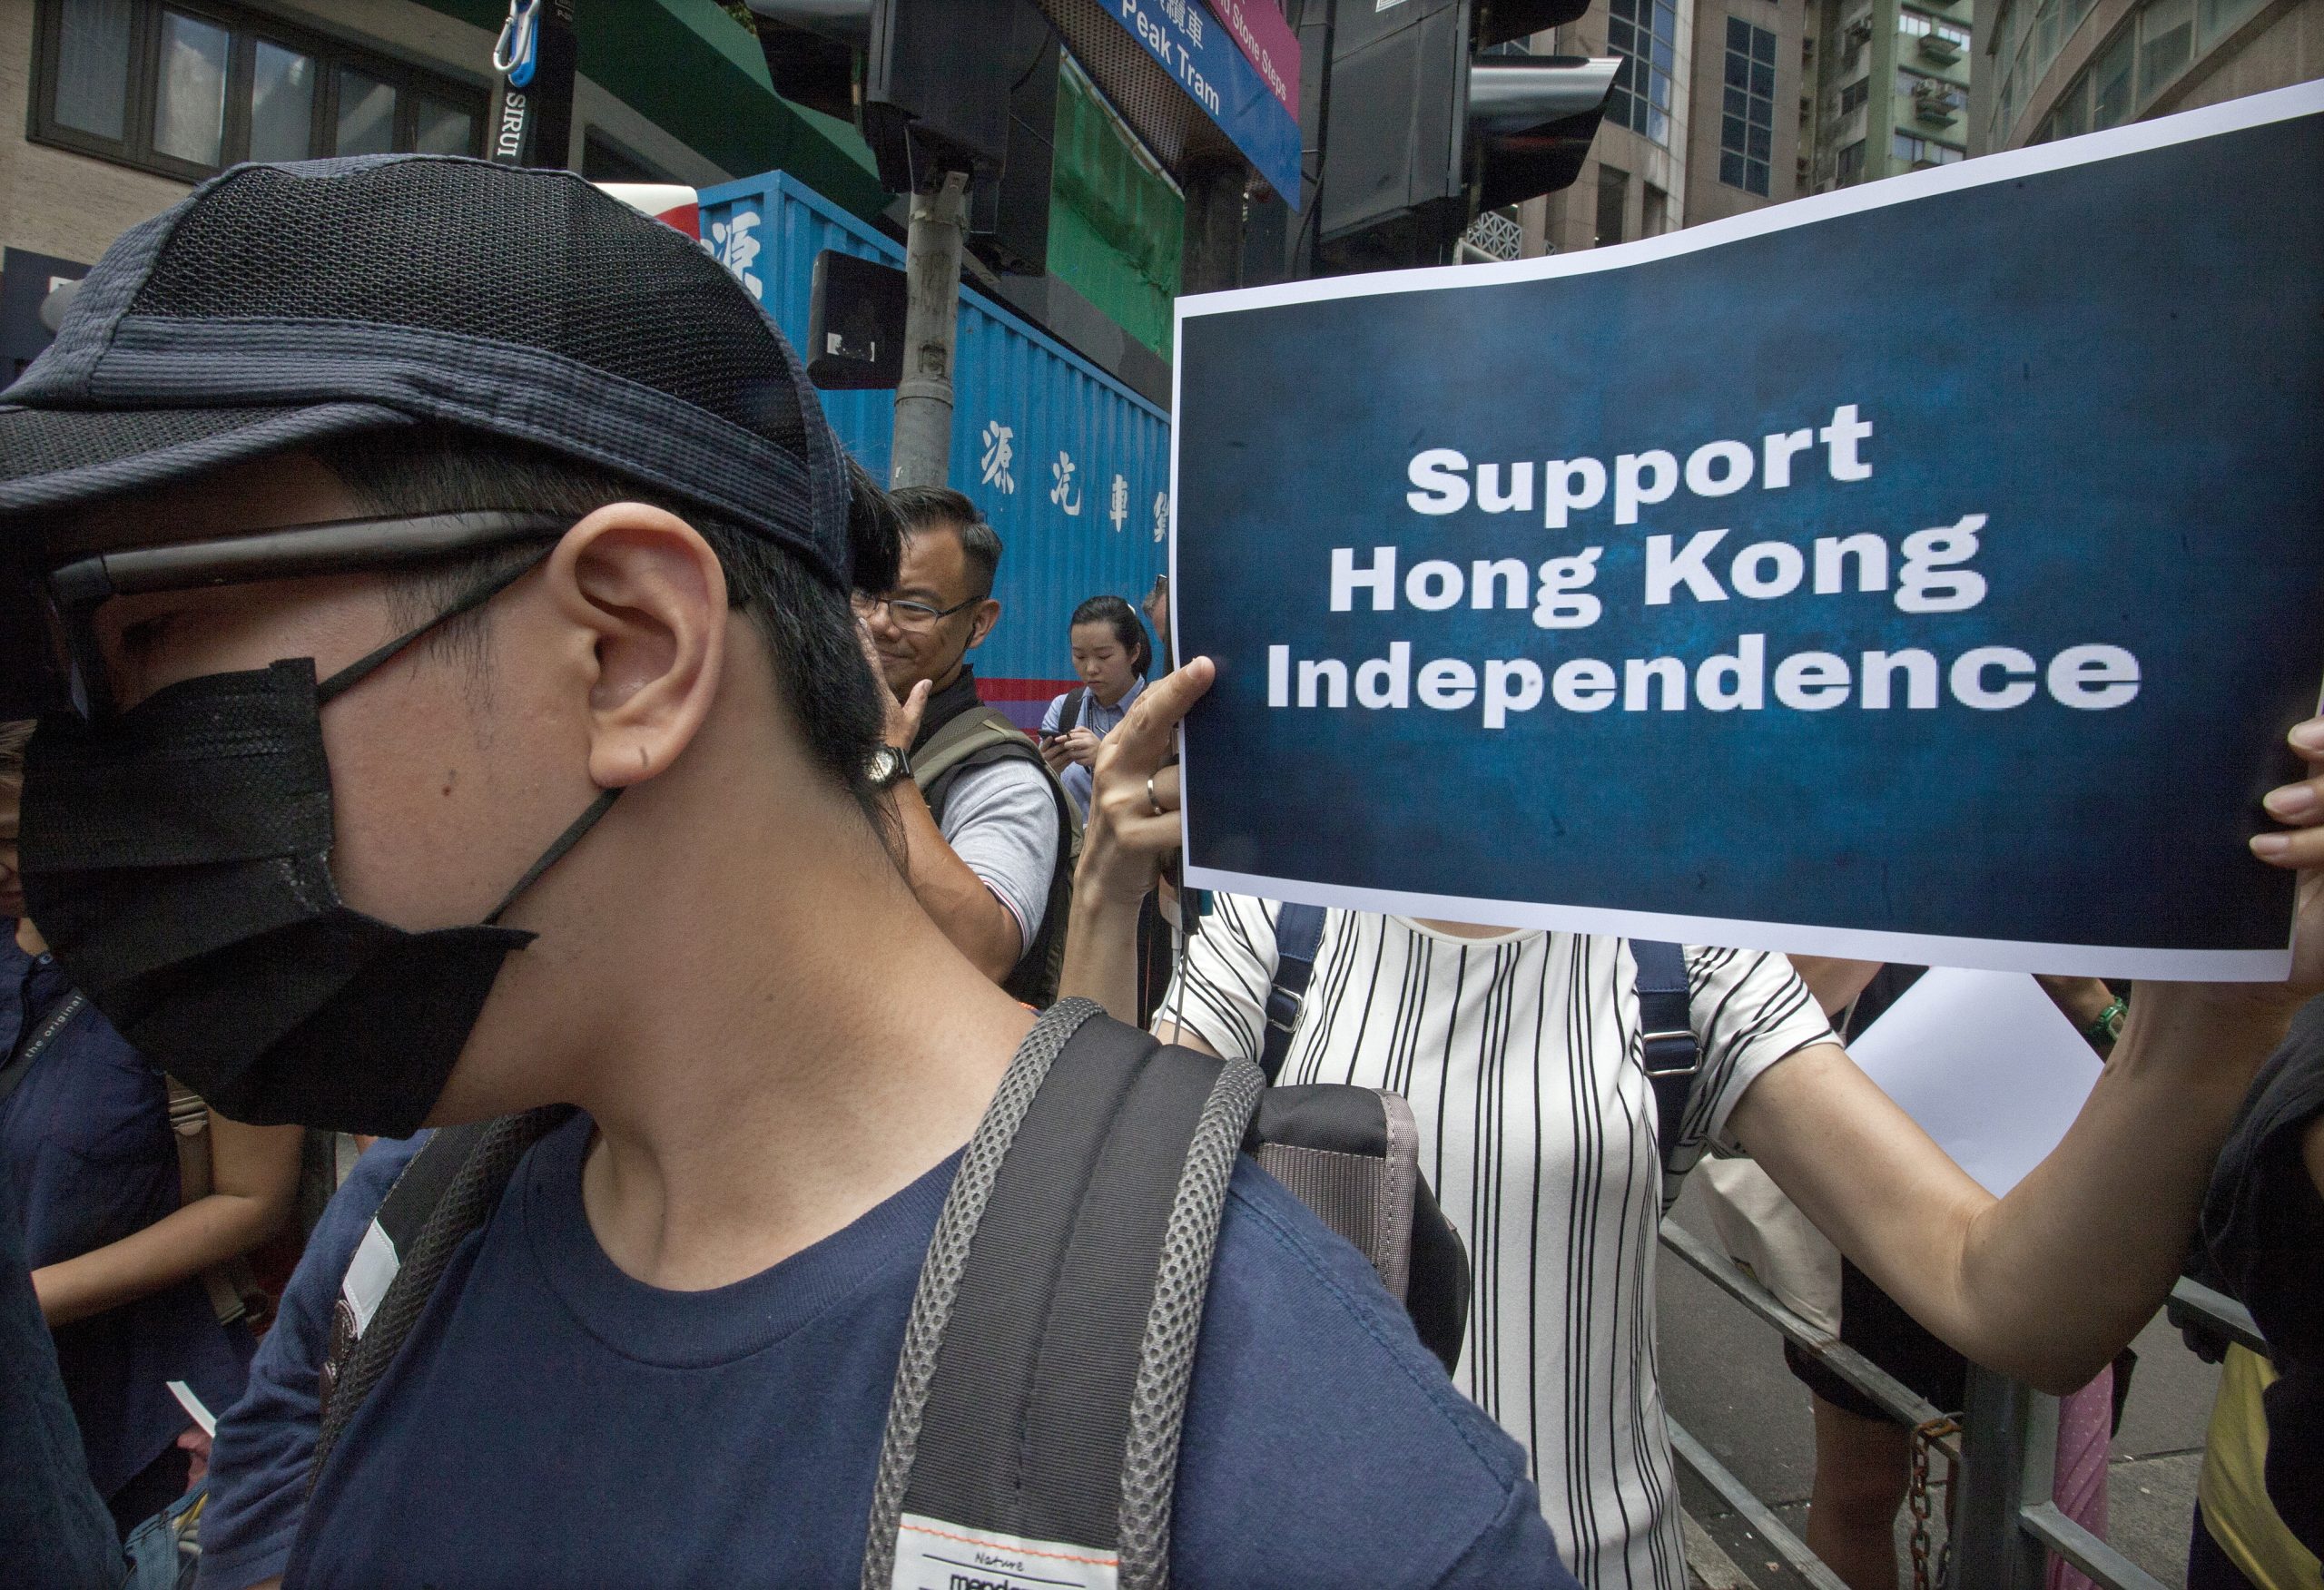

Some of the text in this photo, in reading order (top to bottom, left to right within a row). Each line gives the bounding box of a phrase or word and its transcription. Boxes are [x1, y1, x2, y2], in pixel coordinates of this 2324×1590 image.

[1122, 0, 1219, 116] Peak Tram
[1160, 0, 1204, 50] 纜車
[1233, 3, 1286, 102] Stone Steps
[497, 92, 527, 157] SIRUI
[1406, 403, 1874, 529] Support
[1330, 513, 1988, 630] Hong Kong
[1268, 633, 2140, 729] Independence
[25, 996, 83, 1058] the original
[974, 1552, 1025, 1572] Nature
